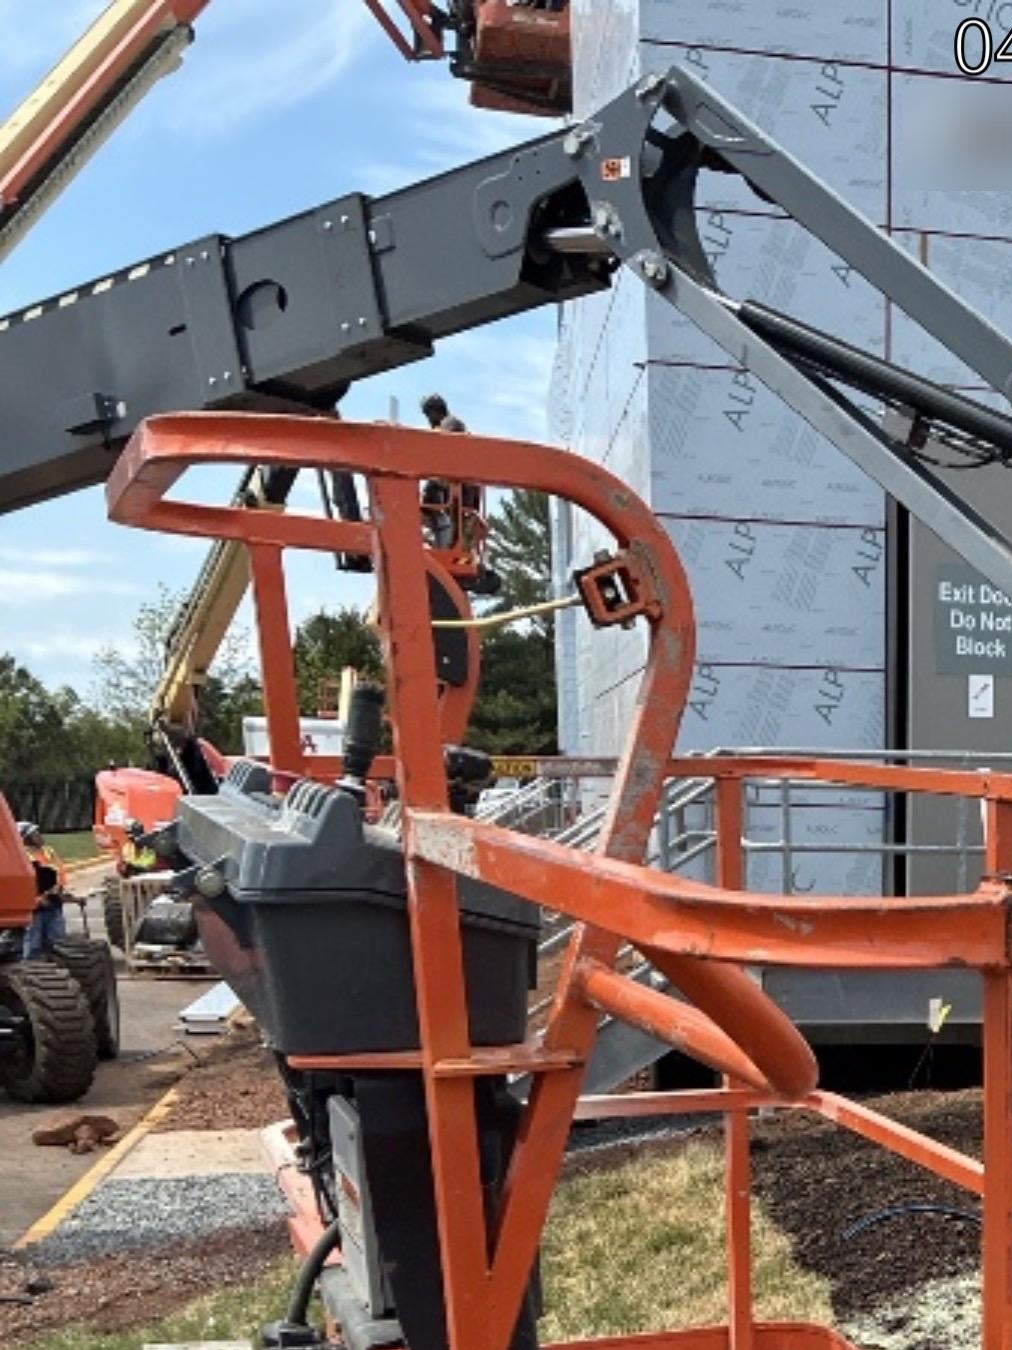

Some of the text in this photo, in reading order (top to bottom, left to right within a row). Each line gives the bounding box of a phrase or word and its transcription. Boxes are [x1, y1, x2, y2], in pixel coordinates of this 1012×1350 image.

[938, 581, 976, 604] Exit
[950, 608, 1012, 632] Do Not
[956, 635, 1006, 658] Block
